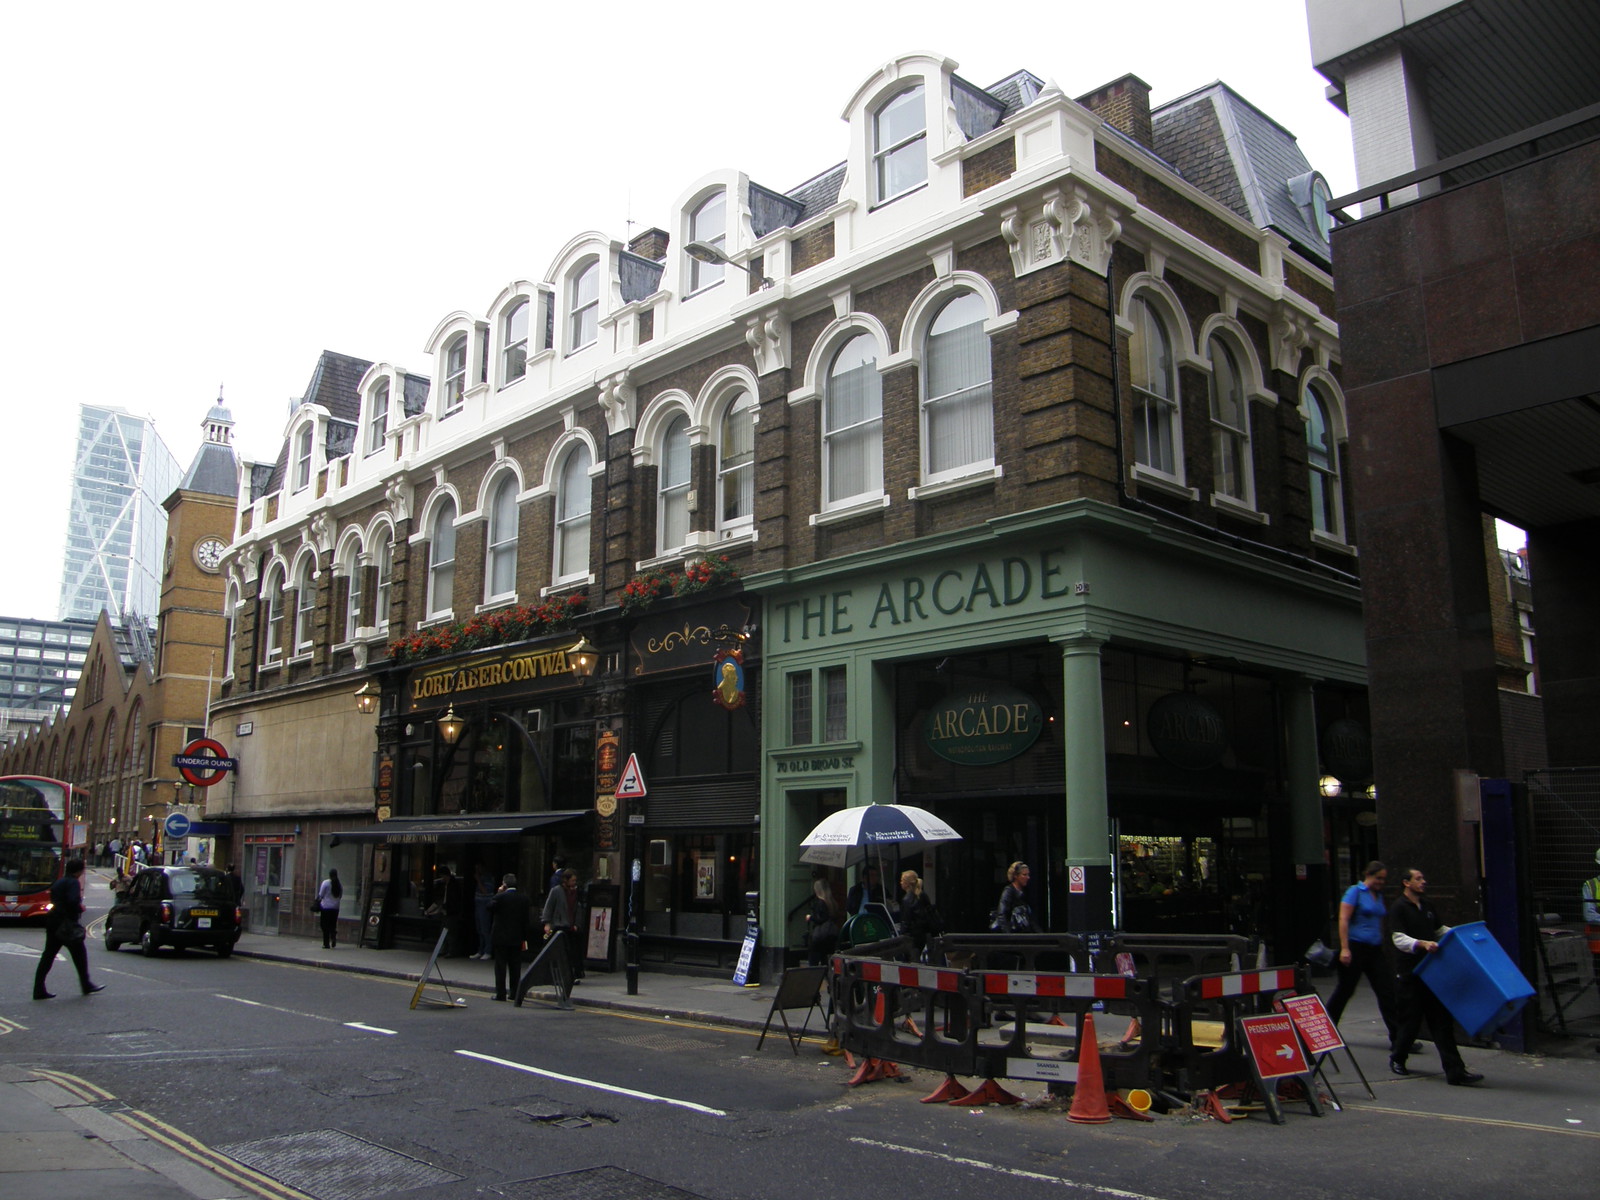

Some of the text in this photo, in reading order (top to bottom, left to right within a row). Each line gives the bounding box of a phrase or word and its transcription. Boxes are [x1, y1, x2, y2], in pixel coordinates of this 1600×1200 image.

[776, 550, 1069, 643] THE ARCADE
[414, 650, 573, 700] LORD ABERCONWA
[968, 692, 989, 704] THE
[930, 704, 1029, 740] ARCADE
[177, 758, 232, 768] UNDERGROUND
[790, 761, 809, 772] OLD
[811, 758, 840, 770] BROAD
[1248, 1022, 1290, 1034] PEDESTRIANS
